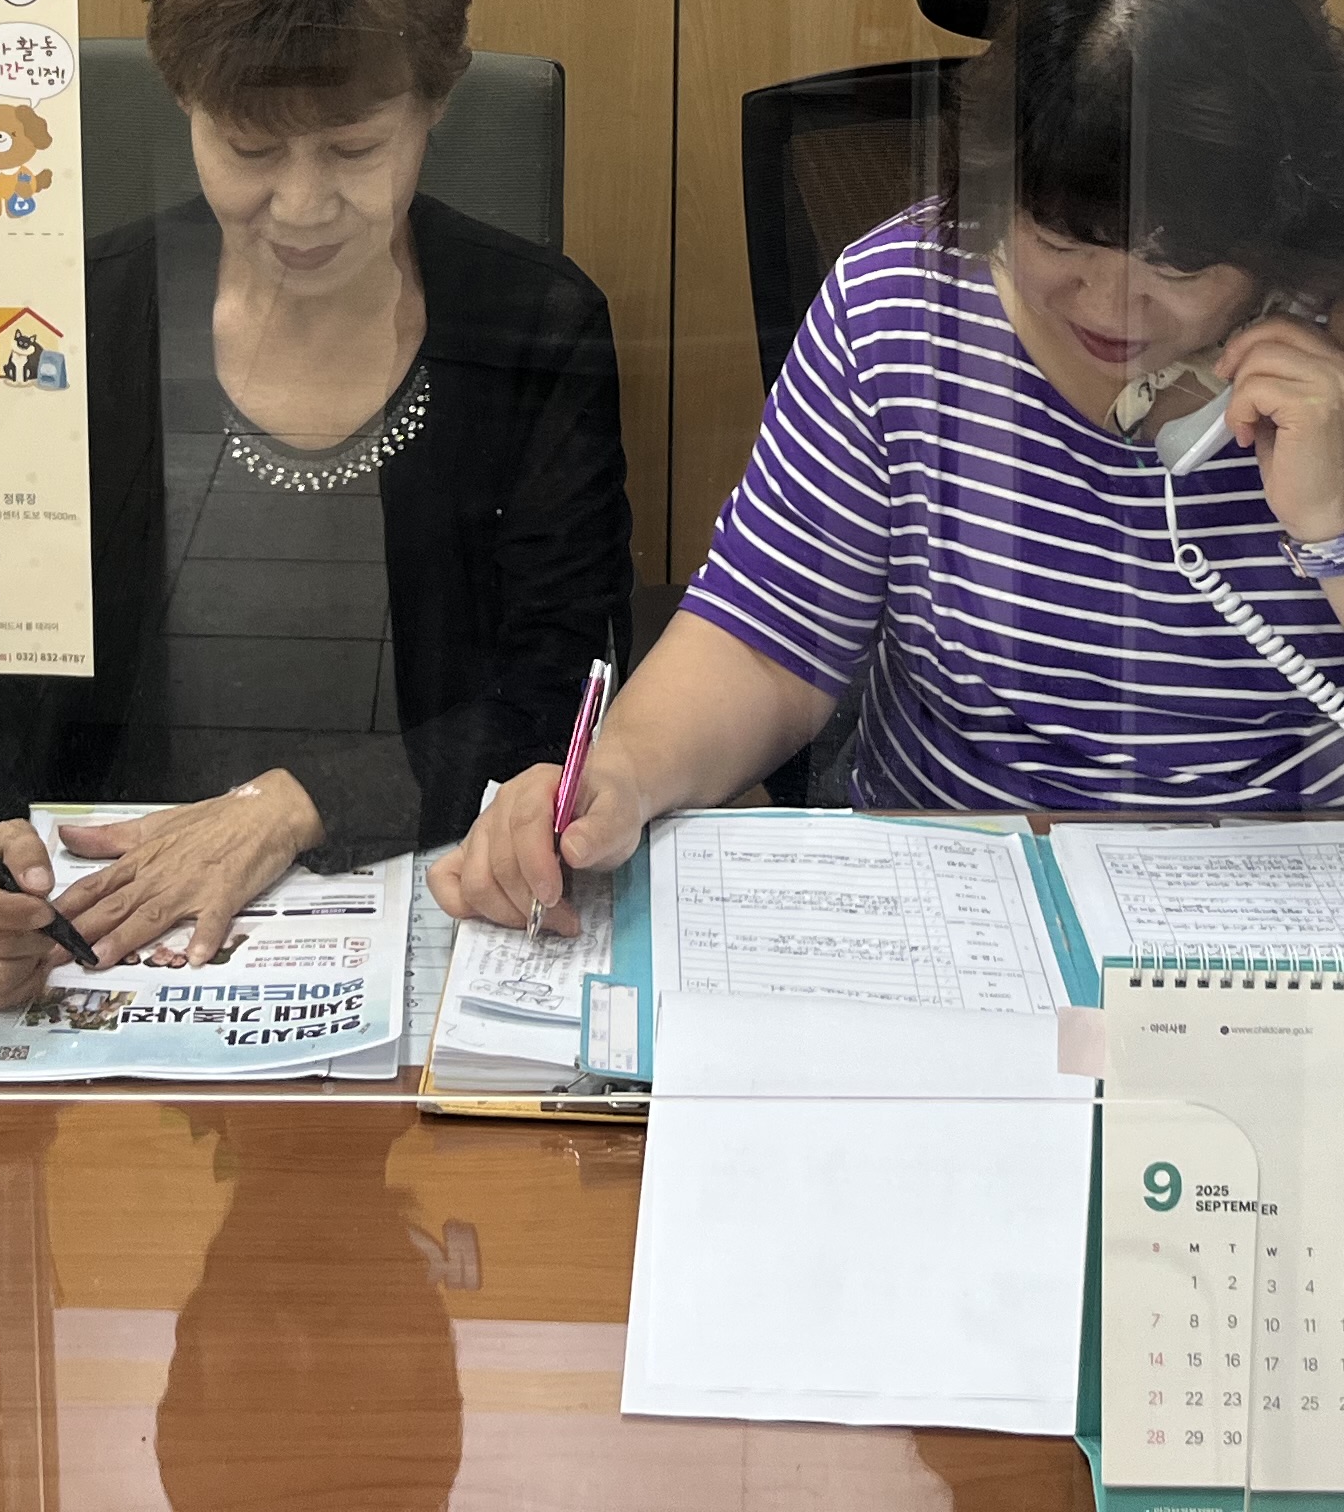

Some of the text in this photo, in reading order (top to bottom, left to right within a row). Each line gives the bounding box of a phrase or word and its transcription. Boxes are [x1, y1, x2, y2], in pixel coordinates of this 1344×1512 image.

[27, 66, 65, 85] 인정!
[155, 978, 364, 1003] 찍어드립니다
[120, 994, 364, 1025] 3세대 가족사진
[223, 1015, 362, 1046] 인천시가
[1143, 1161, 1182, 1212] 9
[1196, 1185, 1229, 1197] 2025
[1192, 1276, 1197, 1289] 1
[1228, 1276, 1237, 1290] 2
[1267, 1280, 1276, 1293] 3
[1306, 1280, 1314, 1293] 4
[1151, 1313, 1160, 1328] 7
[1190, 1314, 1199, 1328] 8
[1227, 1314, 1237, 1328] 9
[1265, 1318, 1280, 1333] 10
[1306, 1318, 1316, 1333] 11
[1149, 1352, 1164, 1366] 14
[1187, 1352, 1202, 1367] 15
[1225, 1353, 1240, 1367] 16
[1265, 1357, 1279, 1371] 17
[1303, 1357, 1318, 1371] 18
[1148, 1391, 1163, 1405] 21
[1185, 1392, 1203, 1406] 22
[1223, 1392, 1242, 1406] 23
[1263, 1396, 1280, 1410] 24
[1301, 1396, 1319, 1410] 25
[1147, 1430, 1242, 1445] 28 29 30
